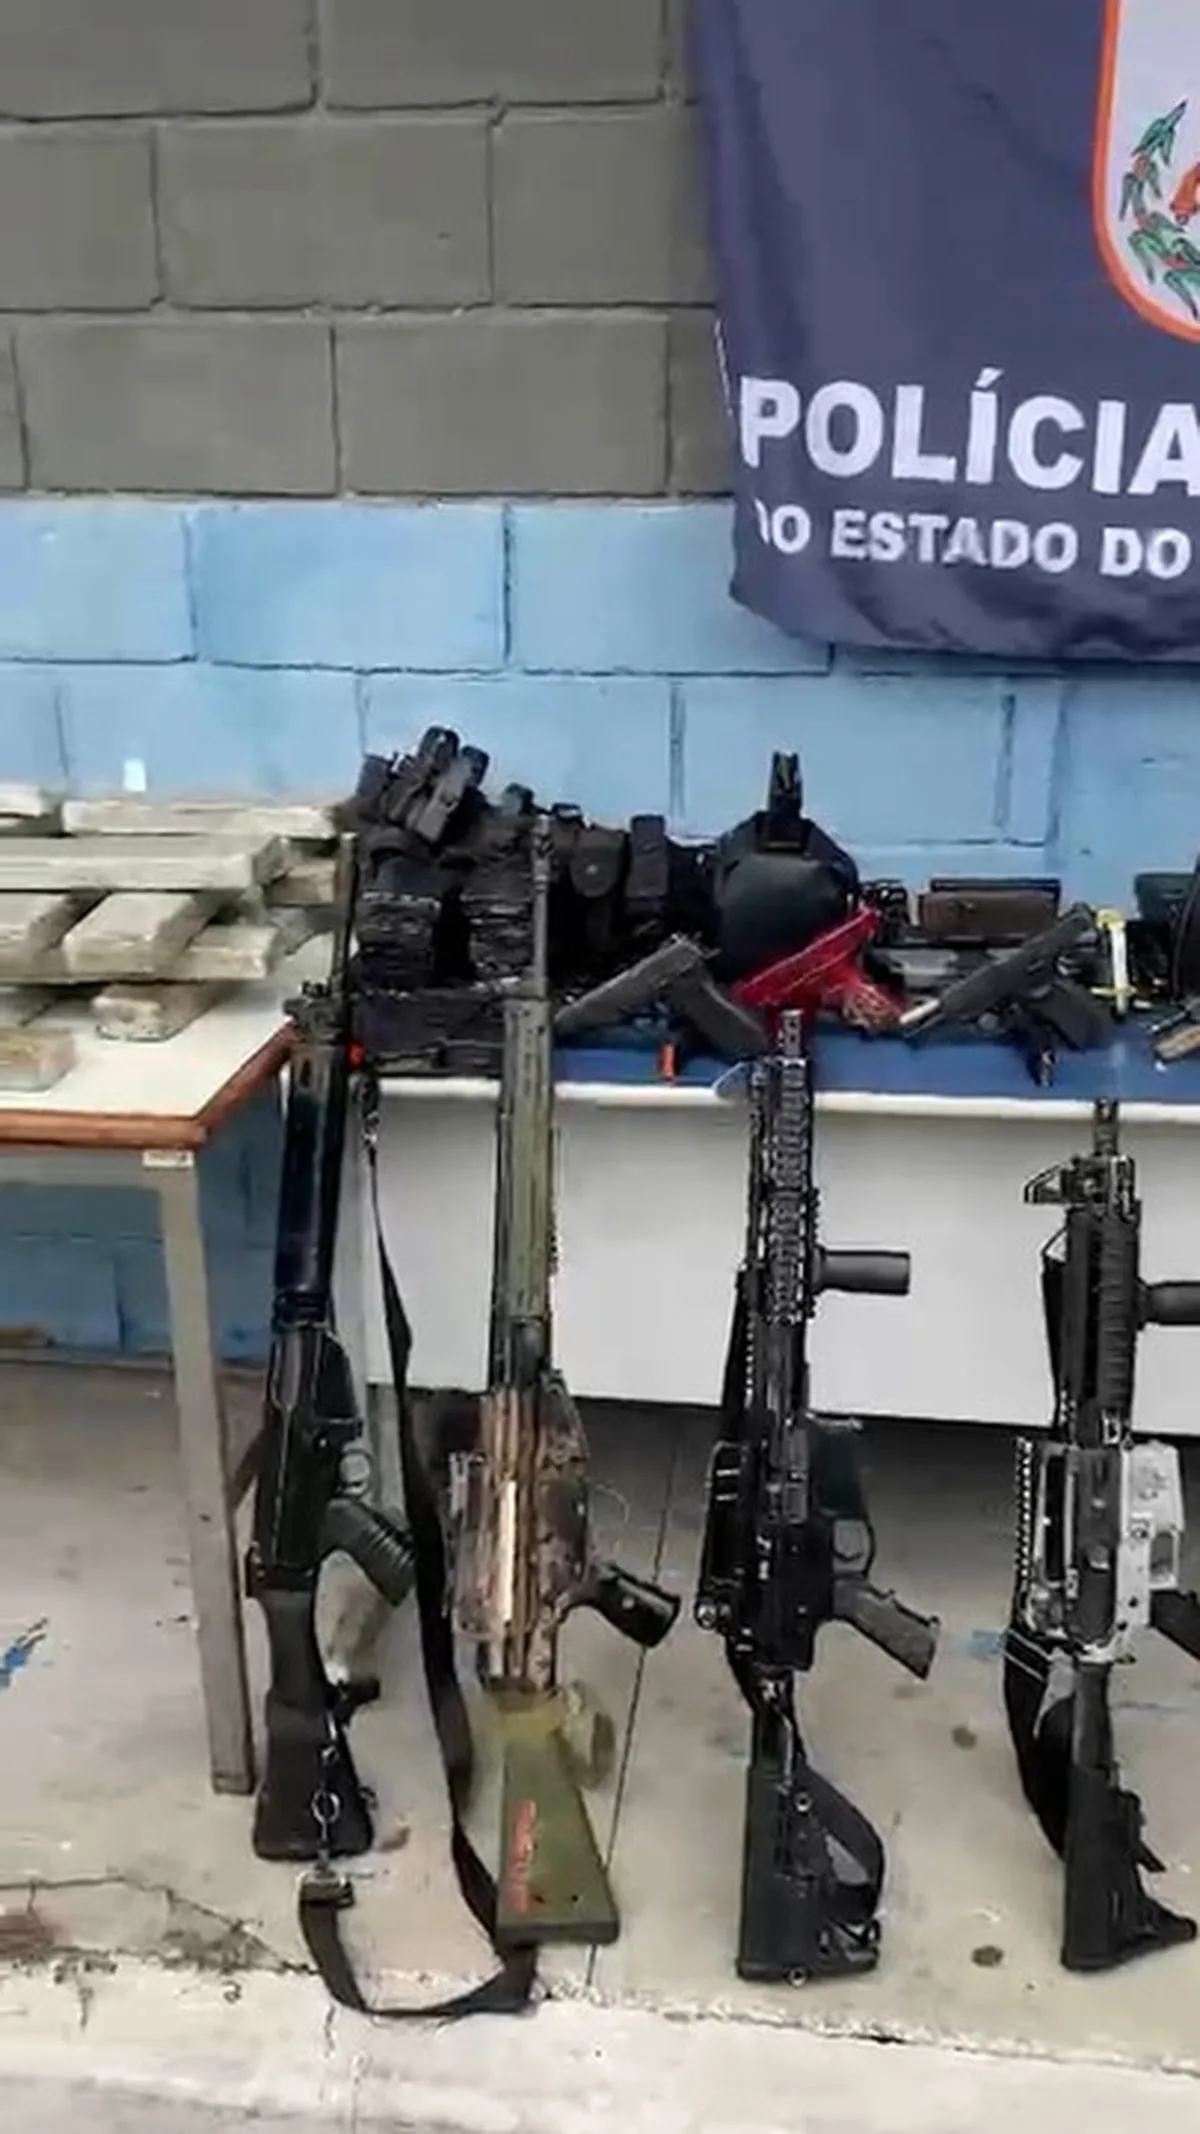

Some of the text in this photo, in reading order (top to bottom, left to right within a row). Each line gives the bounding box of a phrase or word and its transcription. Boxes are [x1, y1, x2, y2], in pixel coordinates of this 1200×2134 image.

[740, 367, 1200, 497] POLÍCIA
[831, 509, 1079, 573] ESTADO
[1100, 527, 1192, 579] DO
